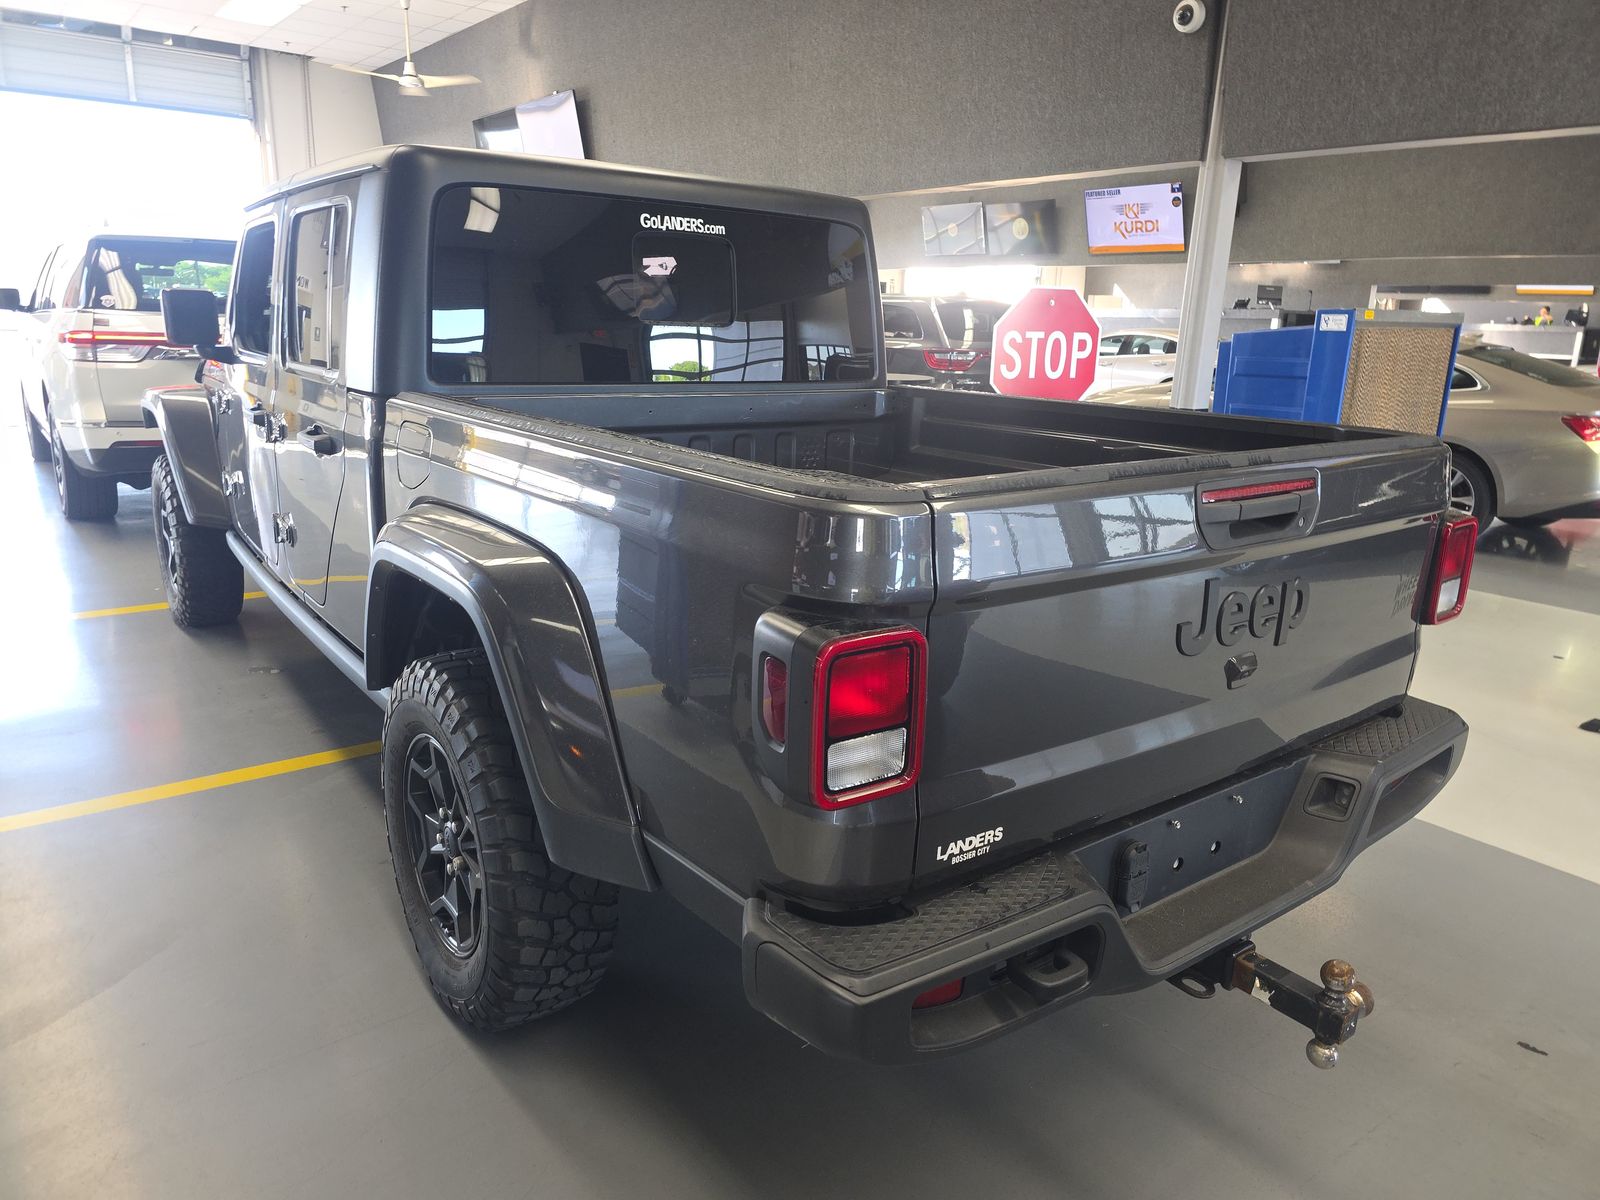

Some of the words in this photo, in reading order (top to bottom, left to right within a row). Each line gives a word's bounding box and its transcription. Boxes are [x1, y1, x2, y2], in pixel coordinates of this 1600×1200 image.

[1113, 219, 1160, 239] KURDI
[1000, 330, 1093, 380] STOP
[1176, 576, 1310, 657] Jeep
[936, 826, 1004, 862] LANDERS
[951, 849, 976, 865] BOSSIER
[977, 845, 991, 857] CITY
